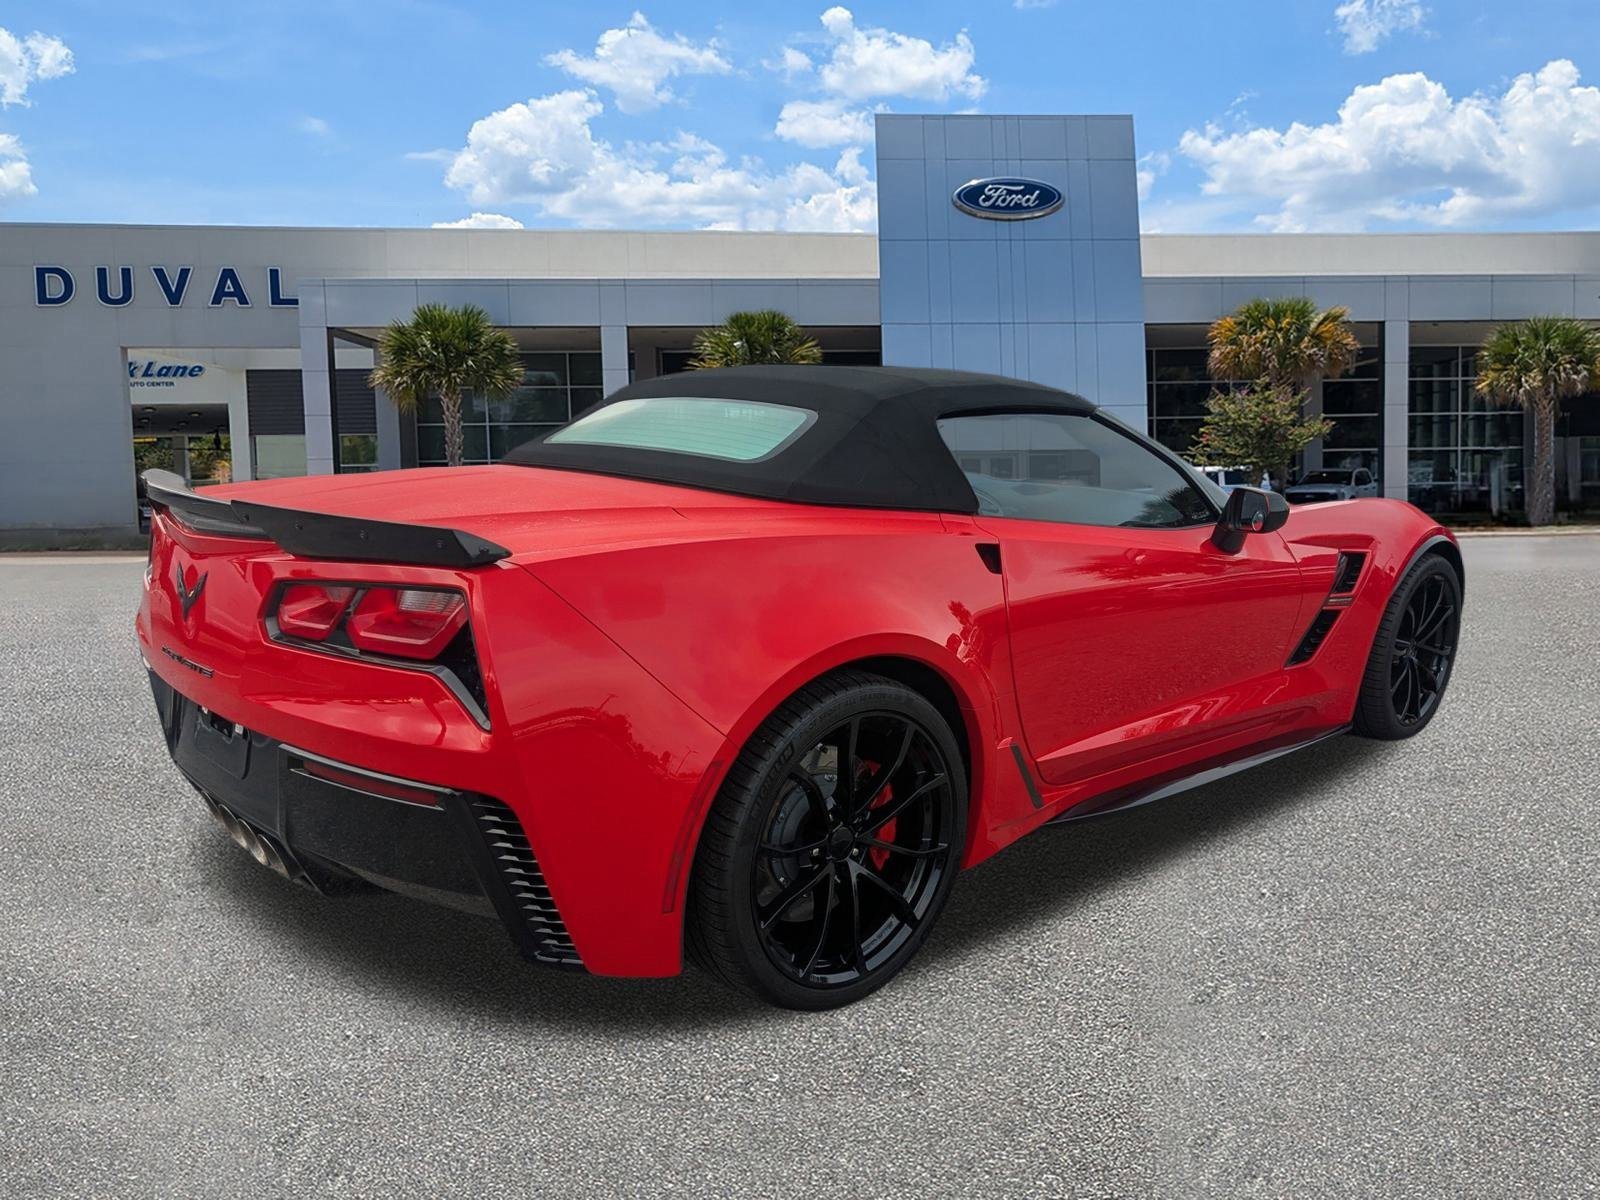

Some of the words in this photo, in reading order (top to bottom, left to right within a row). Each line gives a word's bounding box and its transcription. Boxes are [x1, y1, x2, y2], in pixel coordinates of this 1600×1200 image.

[978, 184, 1040, 207] Ford
[33, 265, 299, 307] DUVAL
[142, 361, 205, 378] Lane
